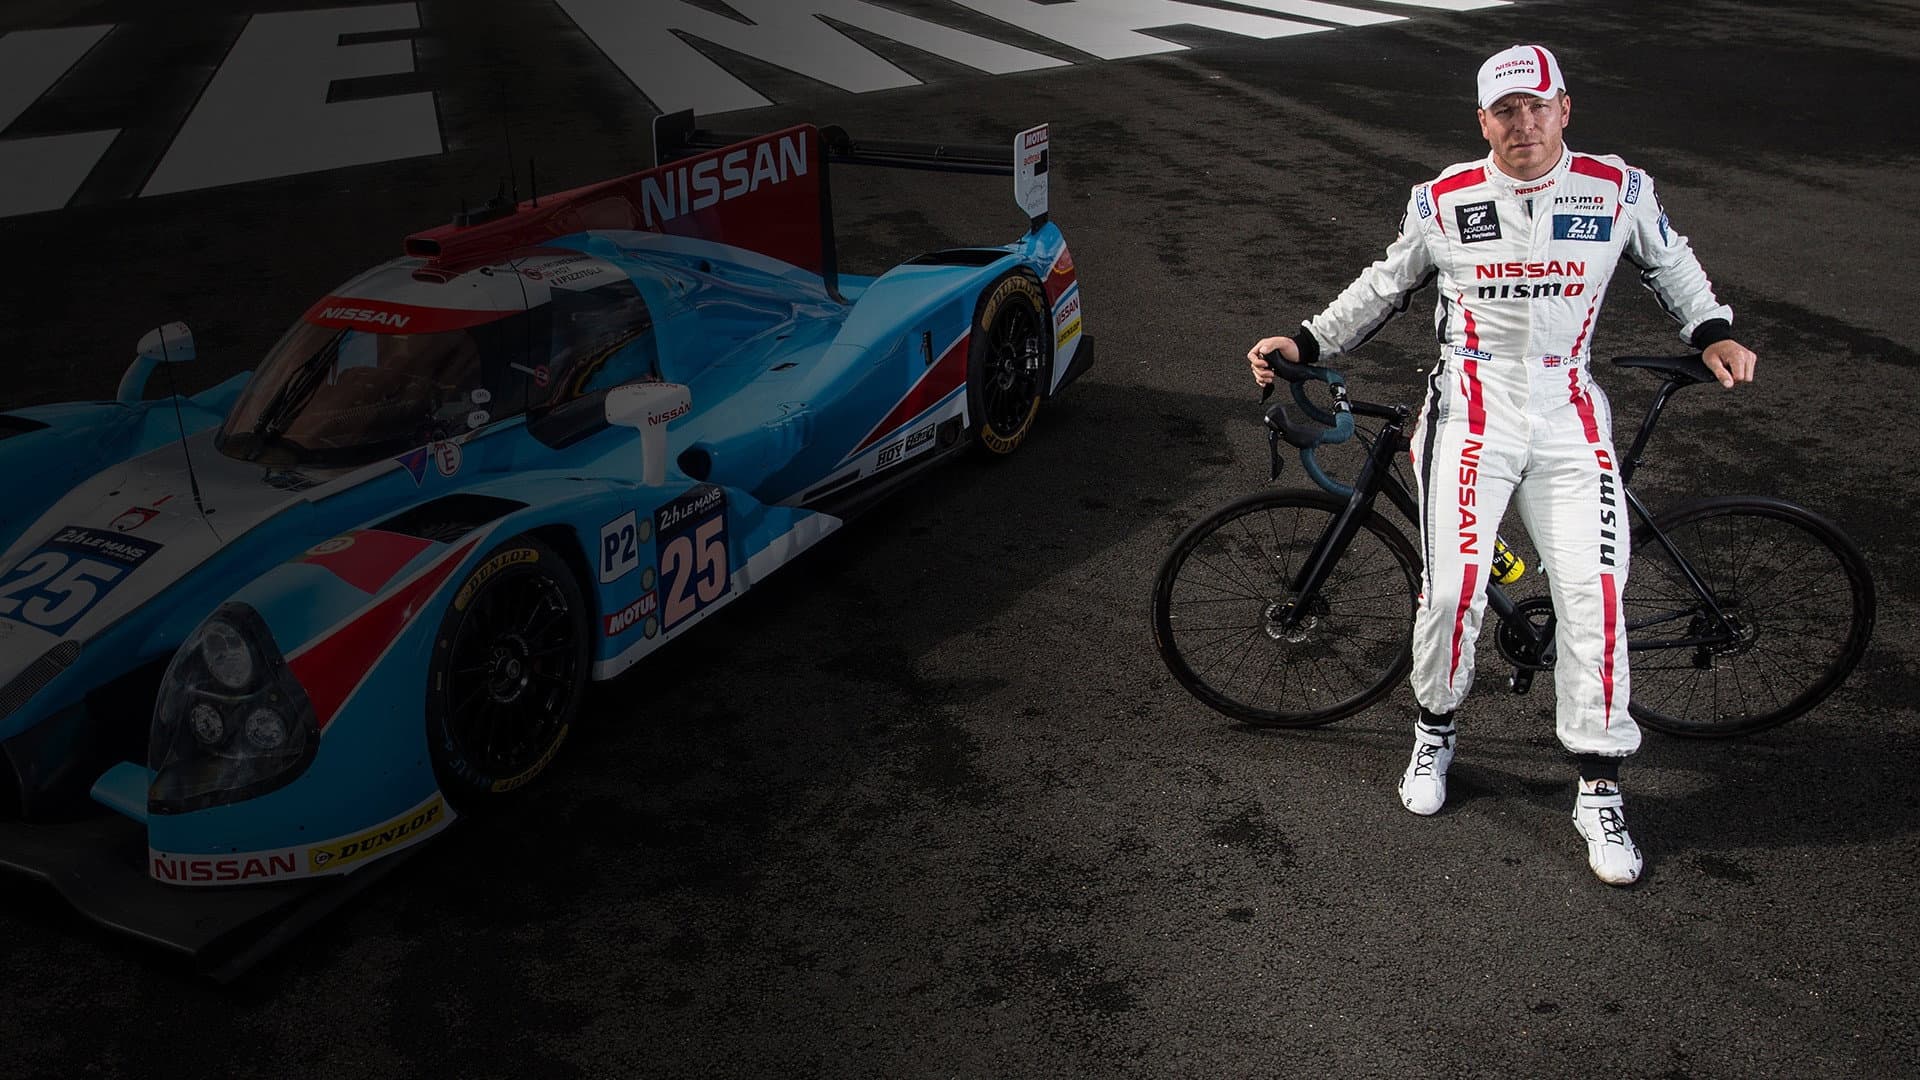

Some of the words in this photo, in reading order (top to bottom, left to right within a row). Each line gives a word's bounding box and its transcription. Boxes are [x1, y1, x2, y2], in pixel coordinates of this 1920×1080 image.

[1495, 59, 1534, 71] NISSAN
[1495, 68, 1535, 79] nismo
[1026, 129, 1048, 147] MOTUL
[640, 130, 808, 226] NISSAN
[1515, 178, 1556, 196] NISSAN
[1463, 204, 1488, 214] NISSAN
[1554, 196, 1604, 204] nismo
[1463, 224, 1496, 234] ACADEMY
[1475, 260, 1585, 279] NISSAN
[1477, 283, 1585, 298] nismo
[318, 306, 411, 329] NISSAN
[1055, 296, 1079, 326] NISSAN
[648, 402, 690, 427] NISSAN
[877, 442, 903, 466] HOY
[681, 503, 694, 519] LE
[694, 487, 721, 512] MANS
[1458, 439, 1484, 555] NISSAN
[1594, 449, 1617, 566] nismo
[84, 535, 101, 547] LE
[99, 539, 147, 558] MANS
[604, 524, 636, 572] P2
[467, 549, 532, 592] DUNLOP
[661, 515, 728, 629] 25
[0, 552, 124, 627] 25
[608, 594, 657, 635] MOTUL
[338, 803, 440, 860] DUNLOP
[153, 852, 297, 881] NISSAN
